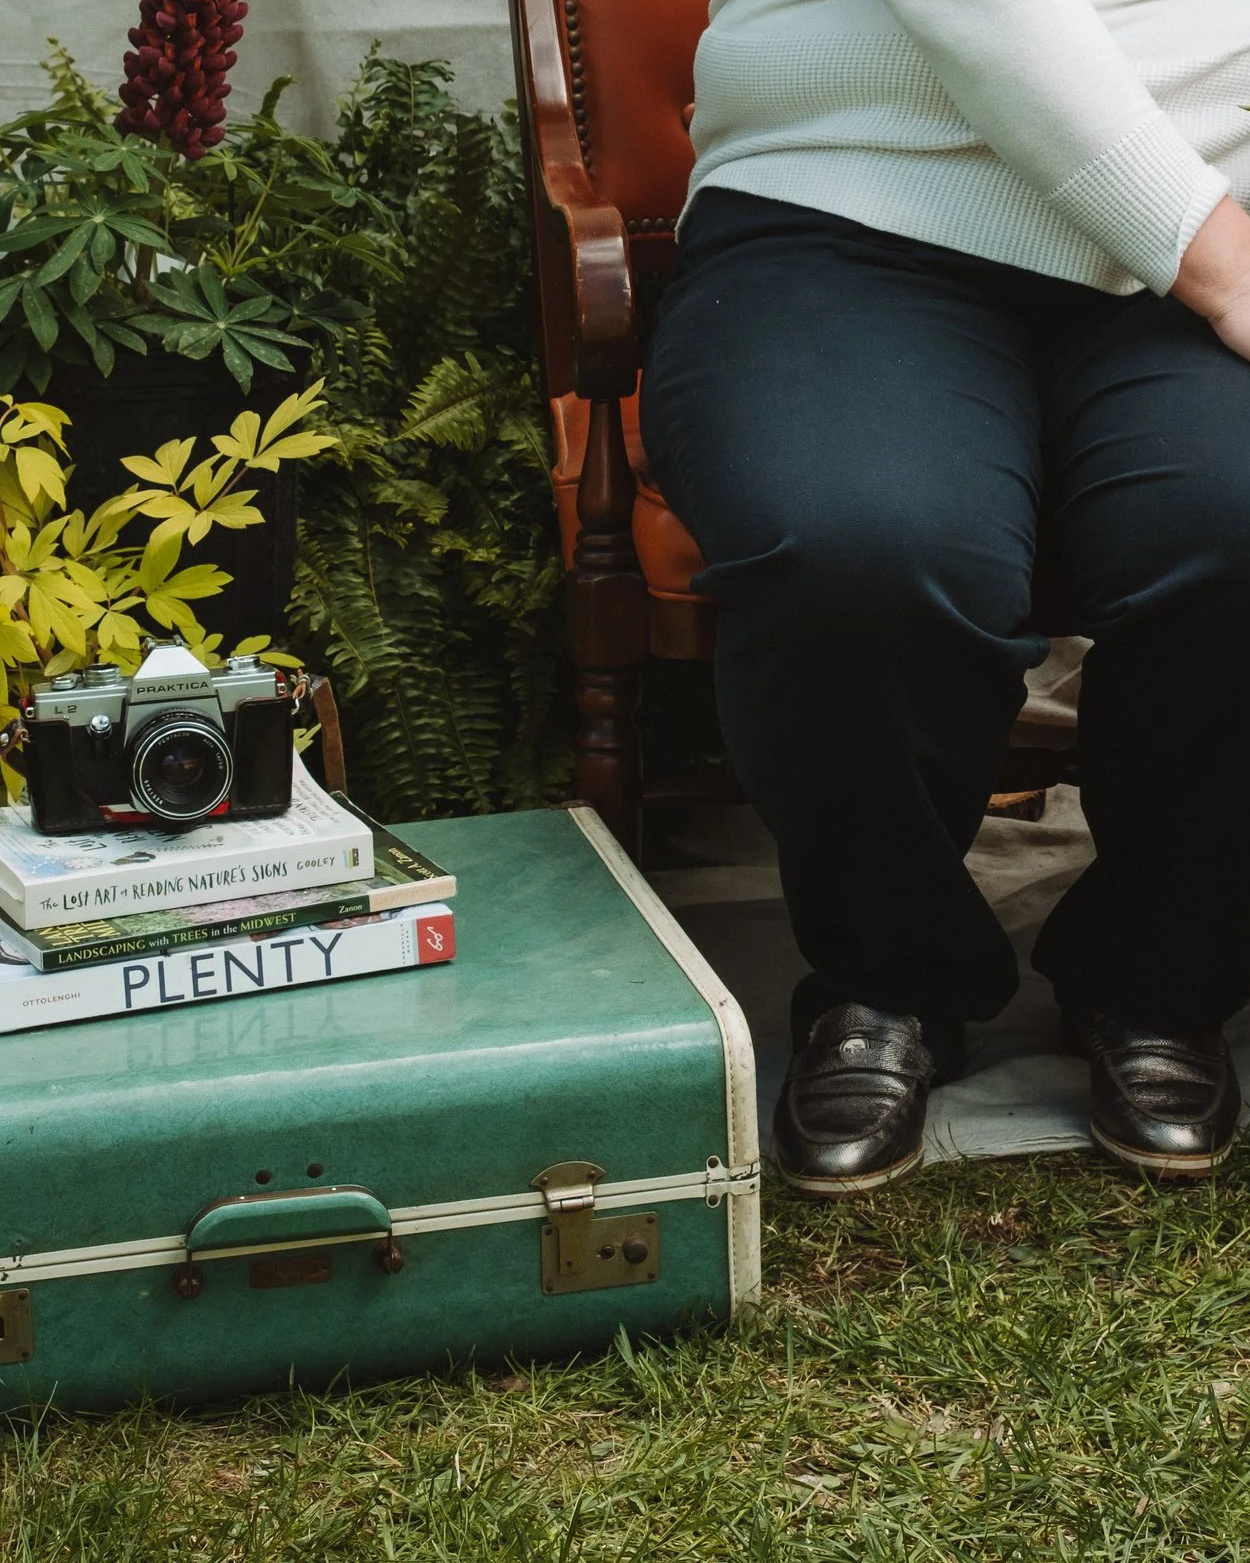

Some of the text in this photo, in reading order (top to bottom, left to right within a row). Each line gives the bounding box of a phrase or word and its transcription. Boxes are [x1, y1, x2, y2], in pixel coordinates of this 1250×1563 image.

[136, 681, 209, 695] PRAKTICA
[55, 704, 77, 714] L 2
[94, 885, 118, 906] ART
[133, 876, 183, 900] READING
[188, 864, 246, 891] NATURE'S
[252, 861, 288, 882] SIGNS
[297, 856, 336, 871] GOOLEY
[338, 903, 363, 914] Zanon
[58, 913, 297, 964] LANDSCAPING with TREES in the MIDWEST
[22, 932, 343, 1009] OTTOLENGHI PLENTY
